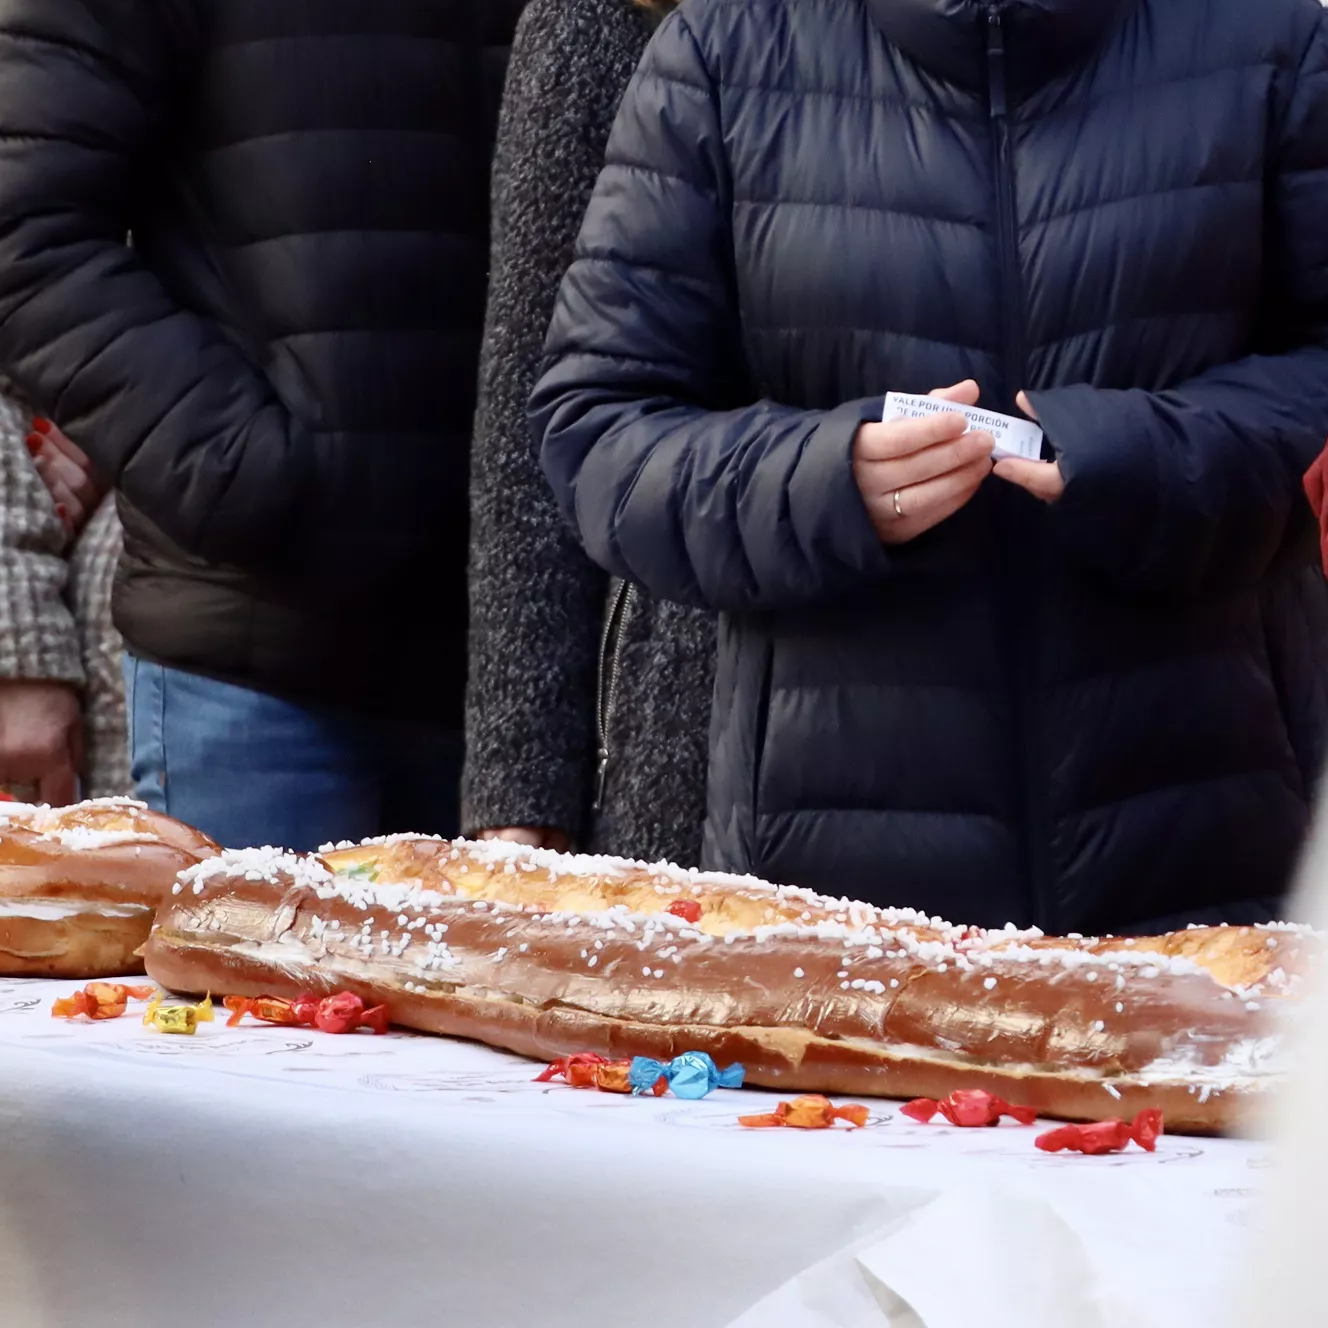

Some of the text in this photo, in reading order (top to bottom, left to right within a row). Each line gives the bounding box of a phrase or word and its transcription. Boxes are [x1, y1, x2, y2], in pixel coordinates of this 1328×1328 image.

[893, 396, 917, 406] VALE
[918, 400, 940, 412] POR
[964, 411, 1009, 429] PORCIÓN
